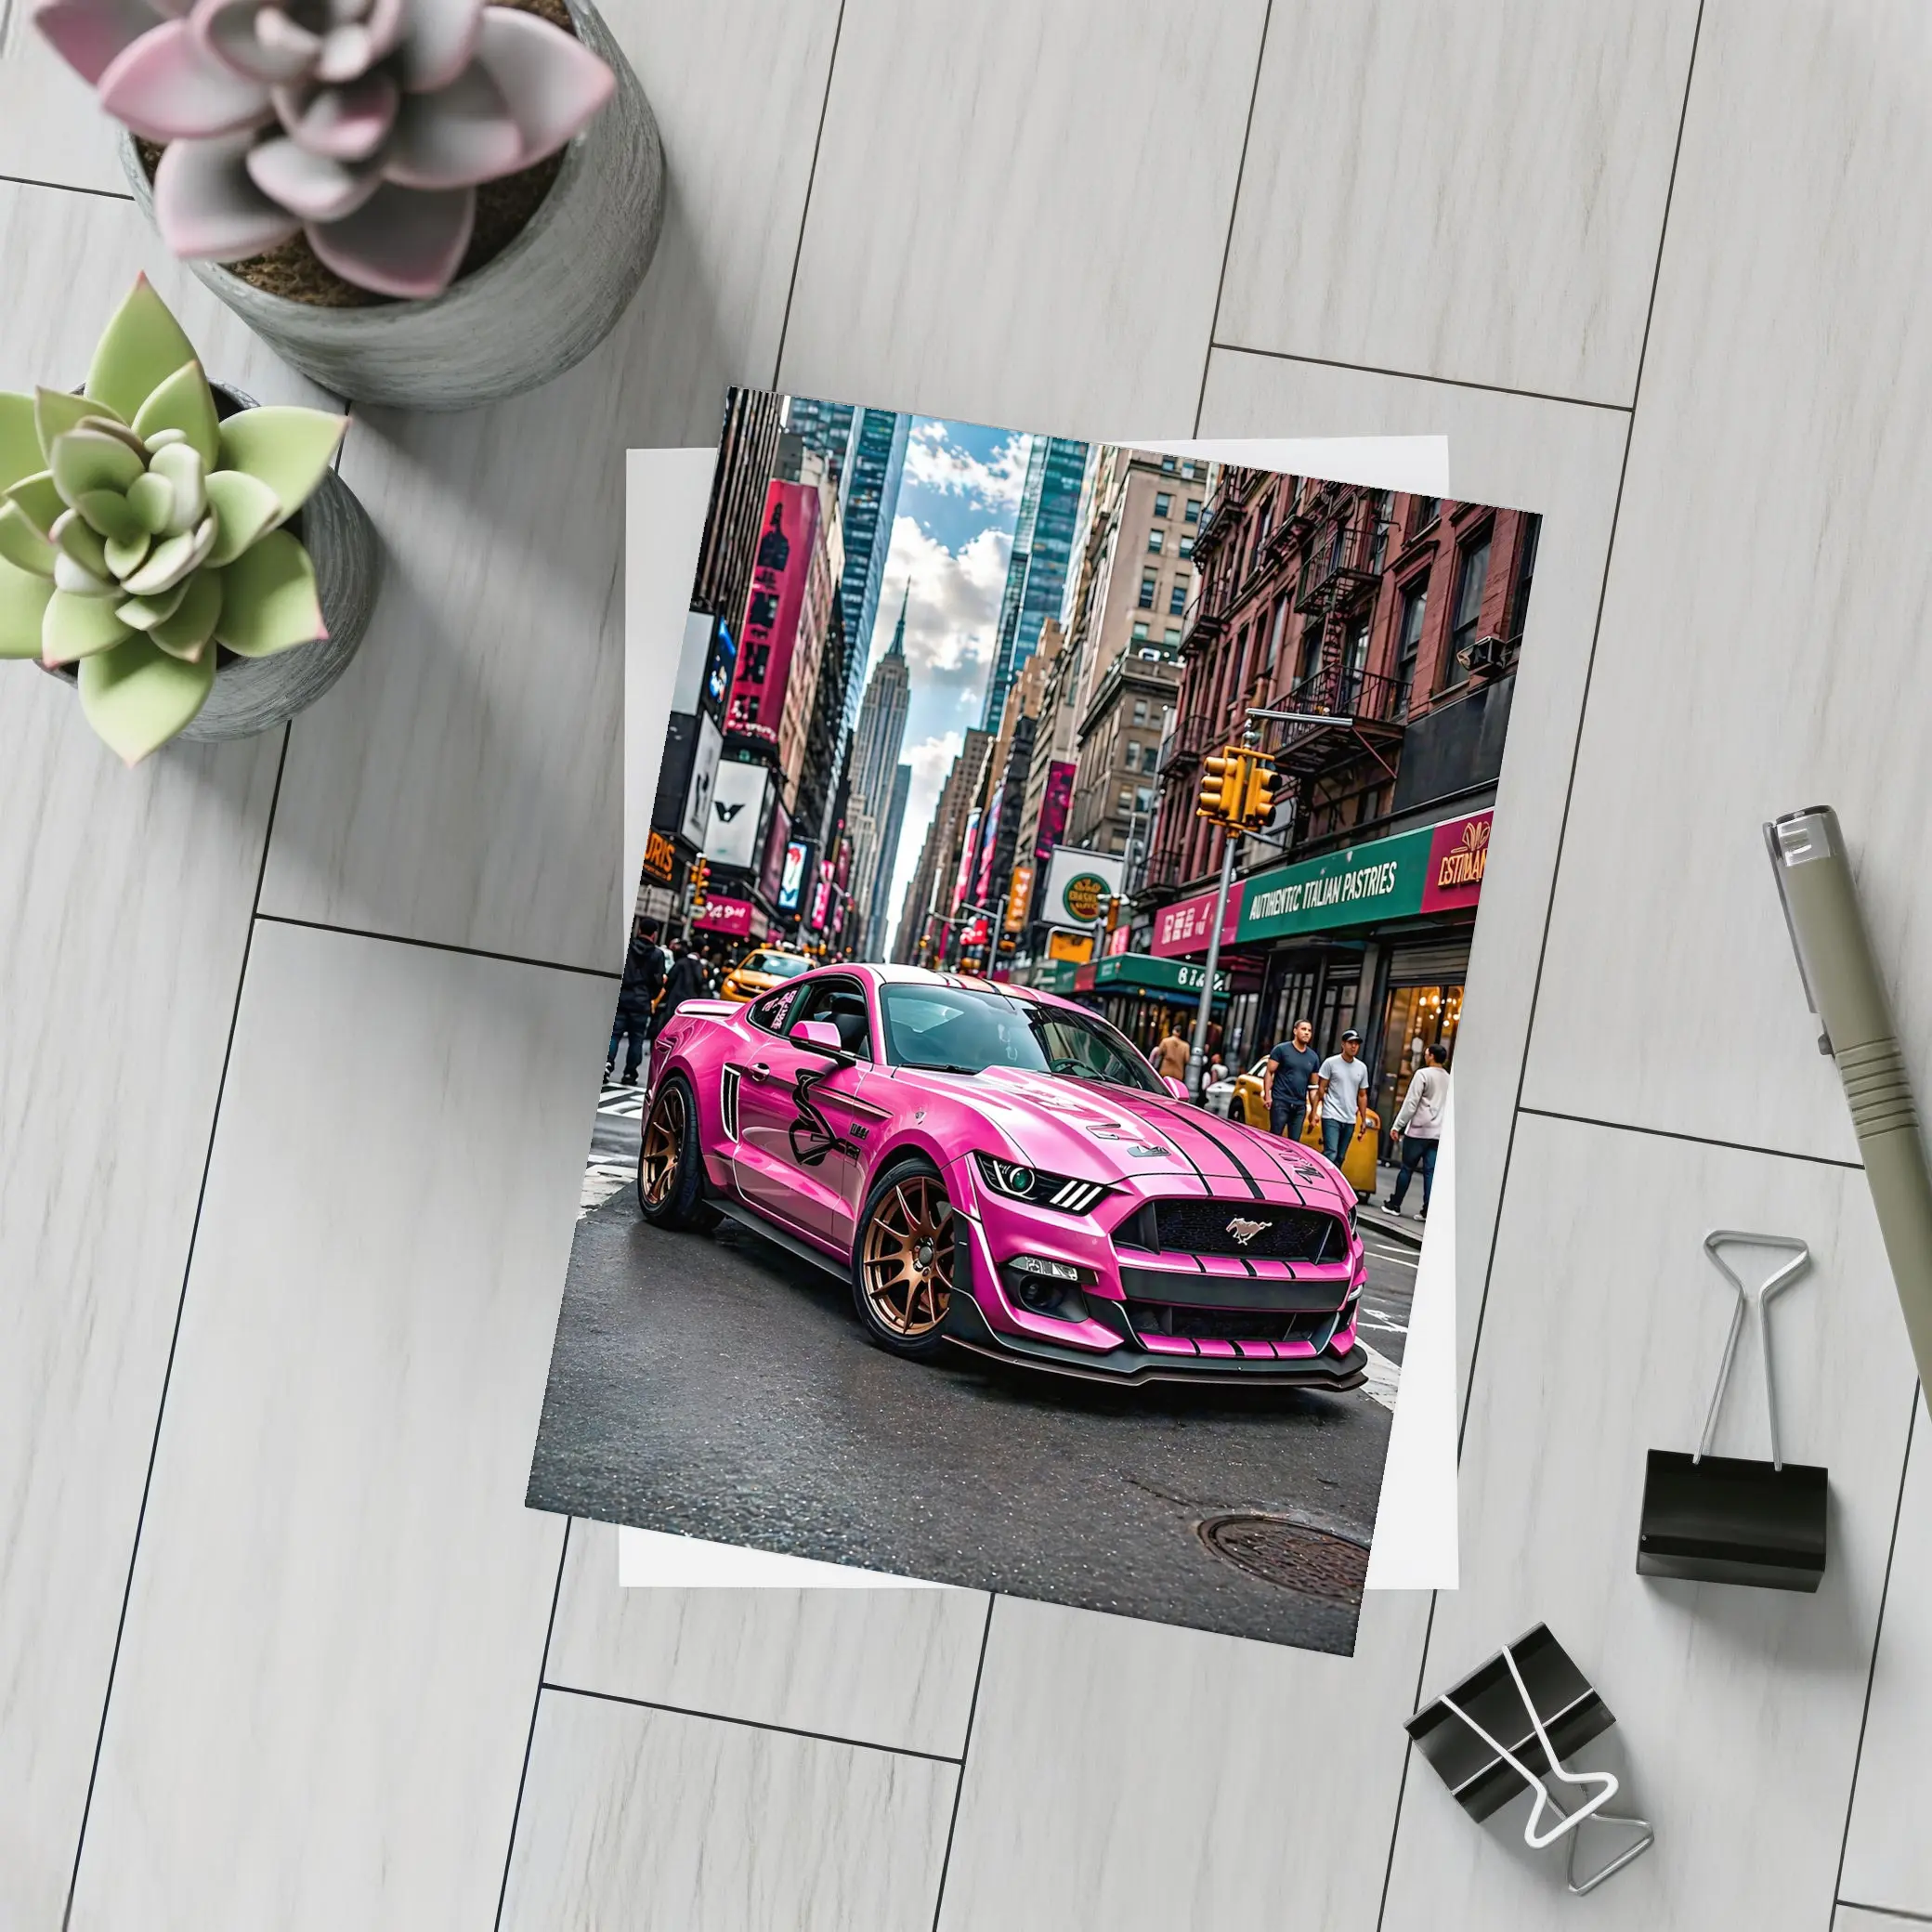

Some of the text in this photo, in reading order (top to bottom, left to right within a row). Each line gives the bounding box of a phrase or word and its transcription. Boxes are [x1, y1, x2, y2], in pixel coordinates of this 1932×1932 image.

[1249, 861, 1398, 920] AUTHENTIC ITALIAN PASTRIES
